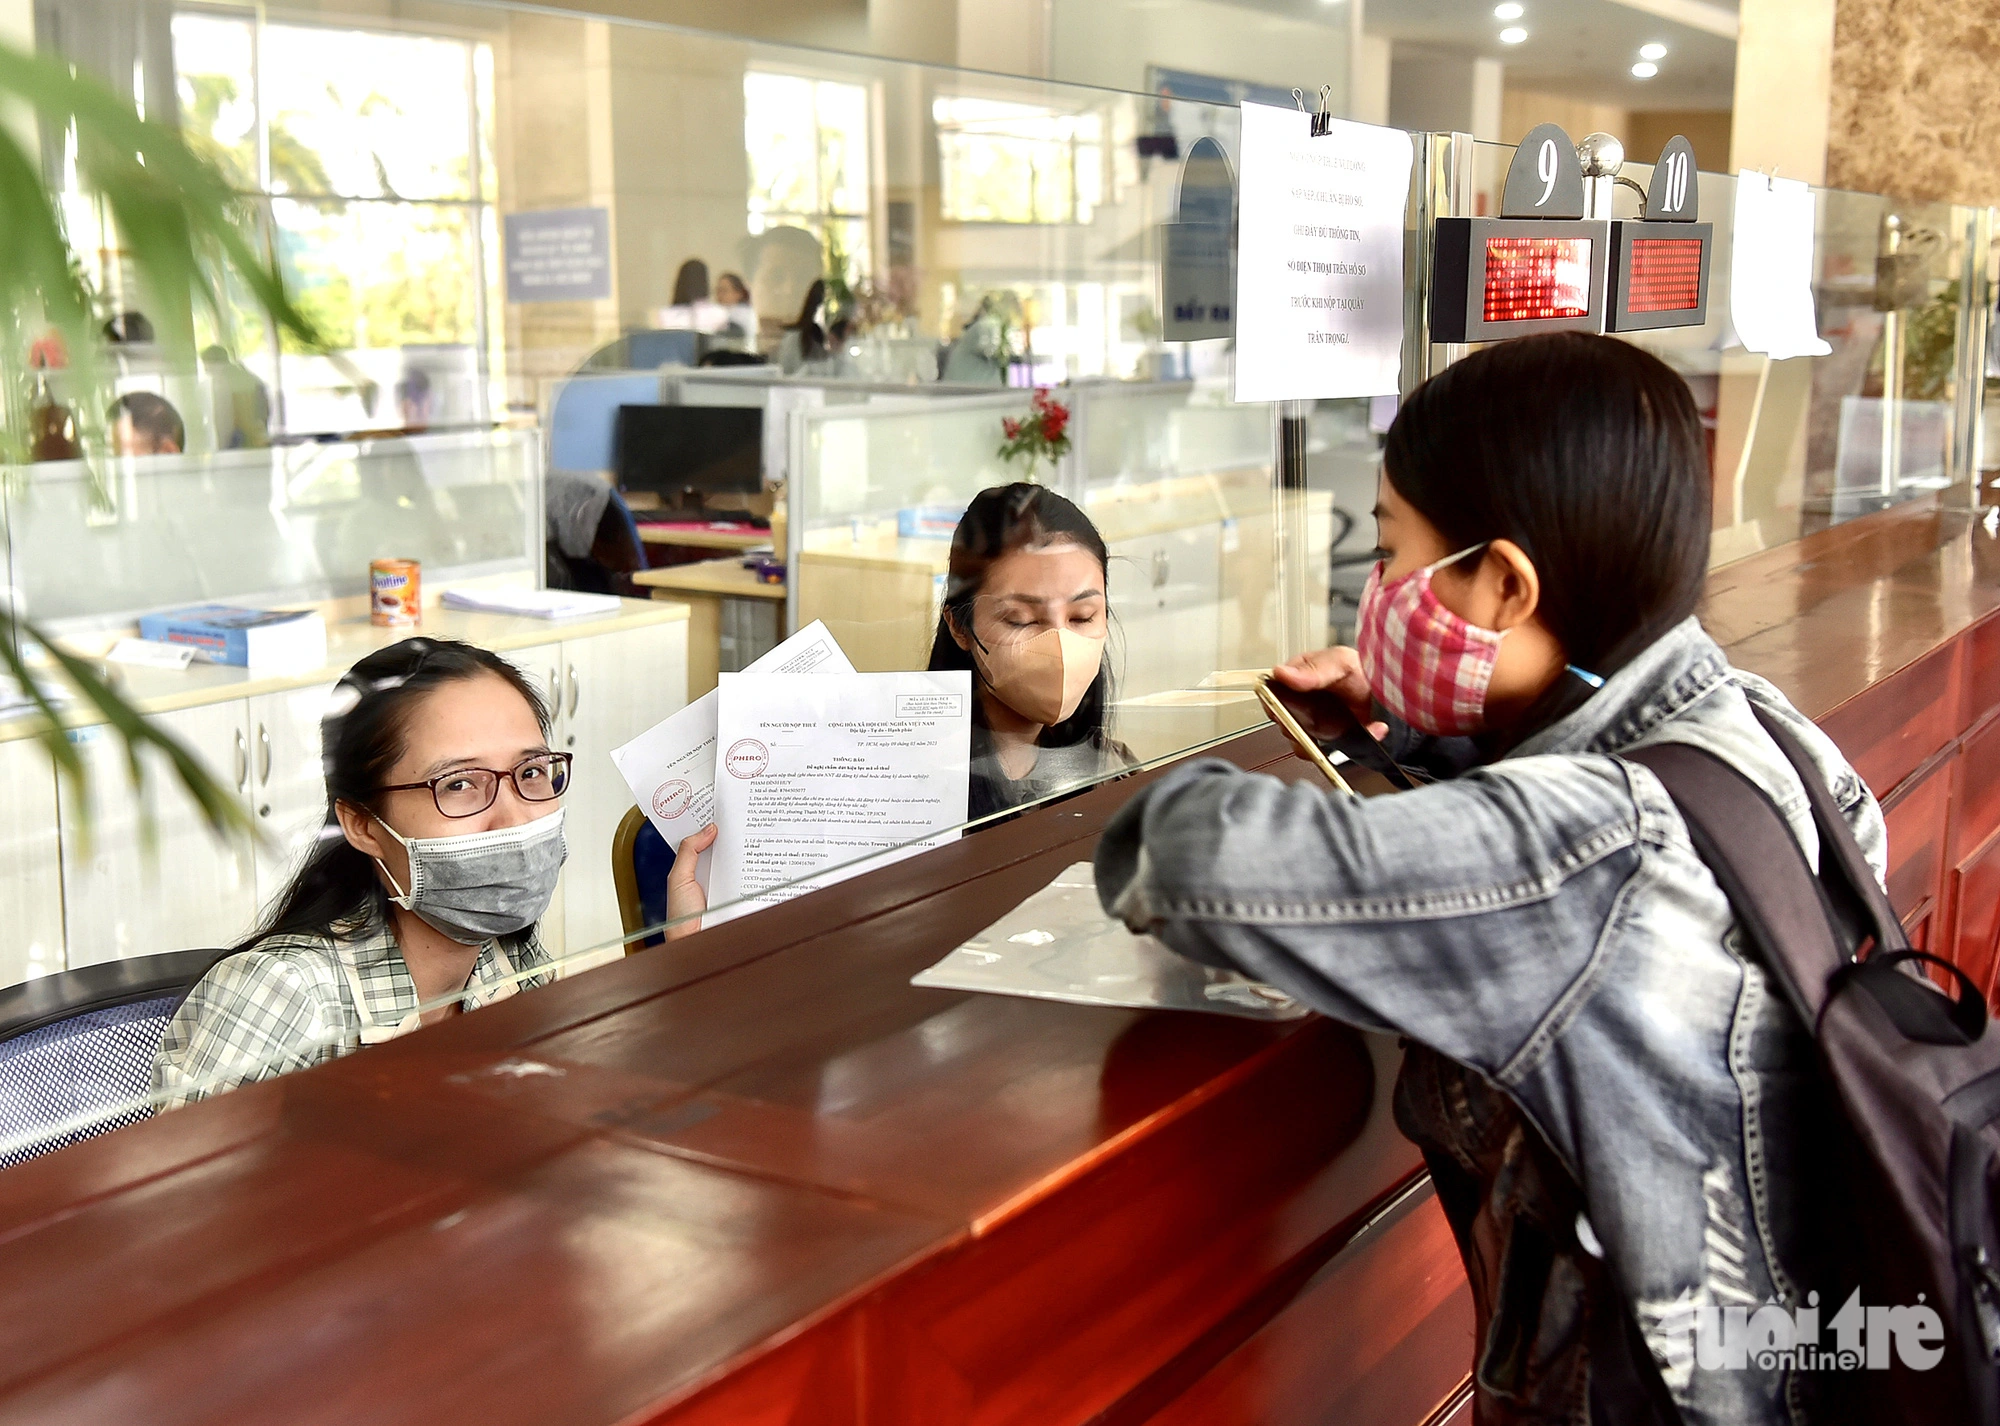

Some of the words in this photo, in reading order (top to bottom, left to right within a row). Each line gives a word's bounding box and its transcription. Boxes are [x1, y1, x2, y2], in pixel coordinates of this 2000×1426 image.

[1534, 138, 1559, 208] 9
[1660, 151, 1689, 213] 10
[659, 788, 685, 808] PHIRO
